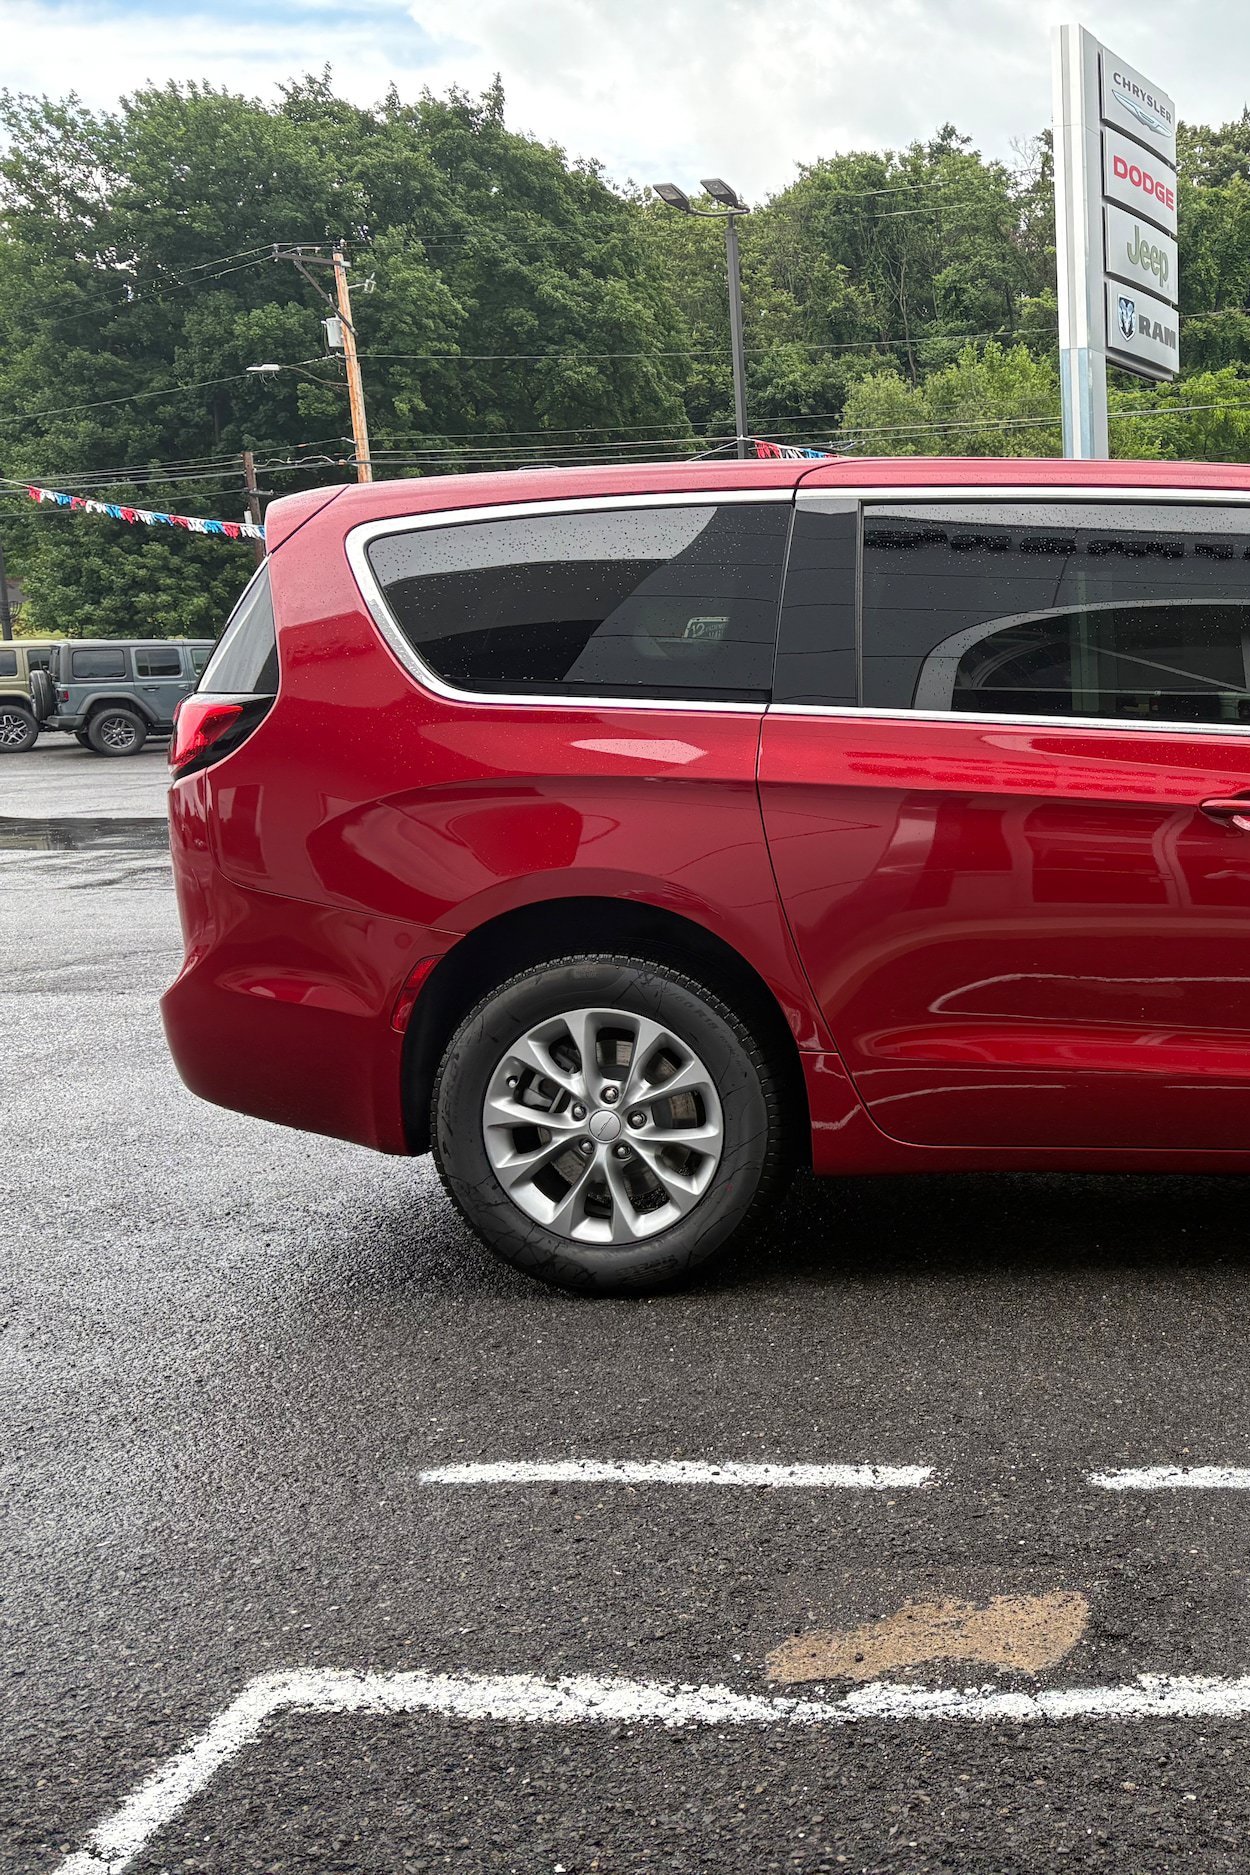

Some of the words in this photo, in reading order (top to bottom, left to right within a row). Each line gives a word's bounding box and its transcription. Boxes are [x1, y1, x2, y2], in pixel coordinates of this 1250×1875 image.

[1113, 72, 1172, 124] CHRYSLER
[1113, 154, 1174, 211] DODGE
[1126, 224, 1169, 287] Jeep
[1138, 314, 1176, 350] RAM
